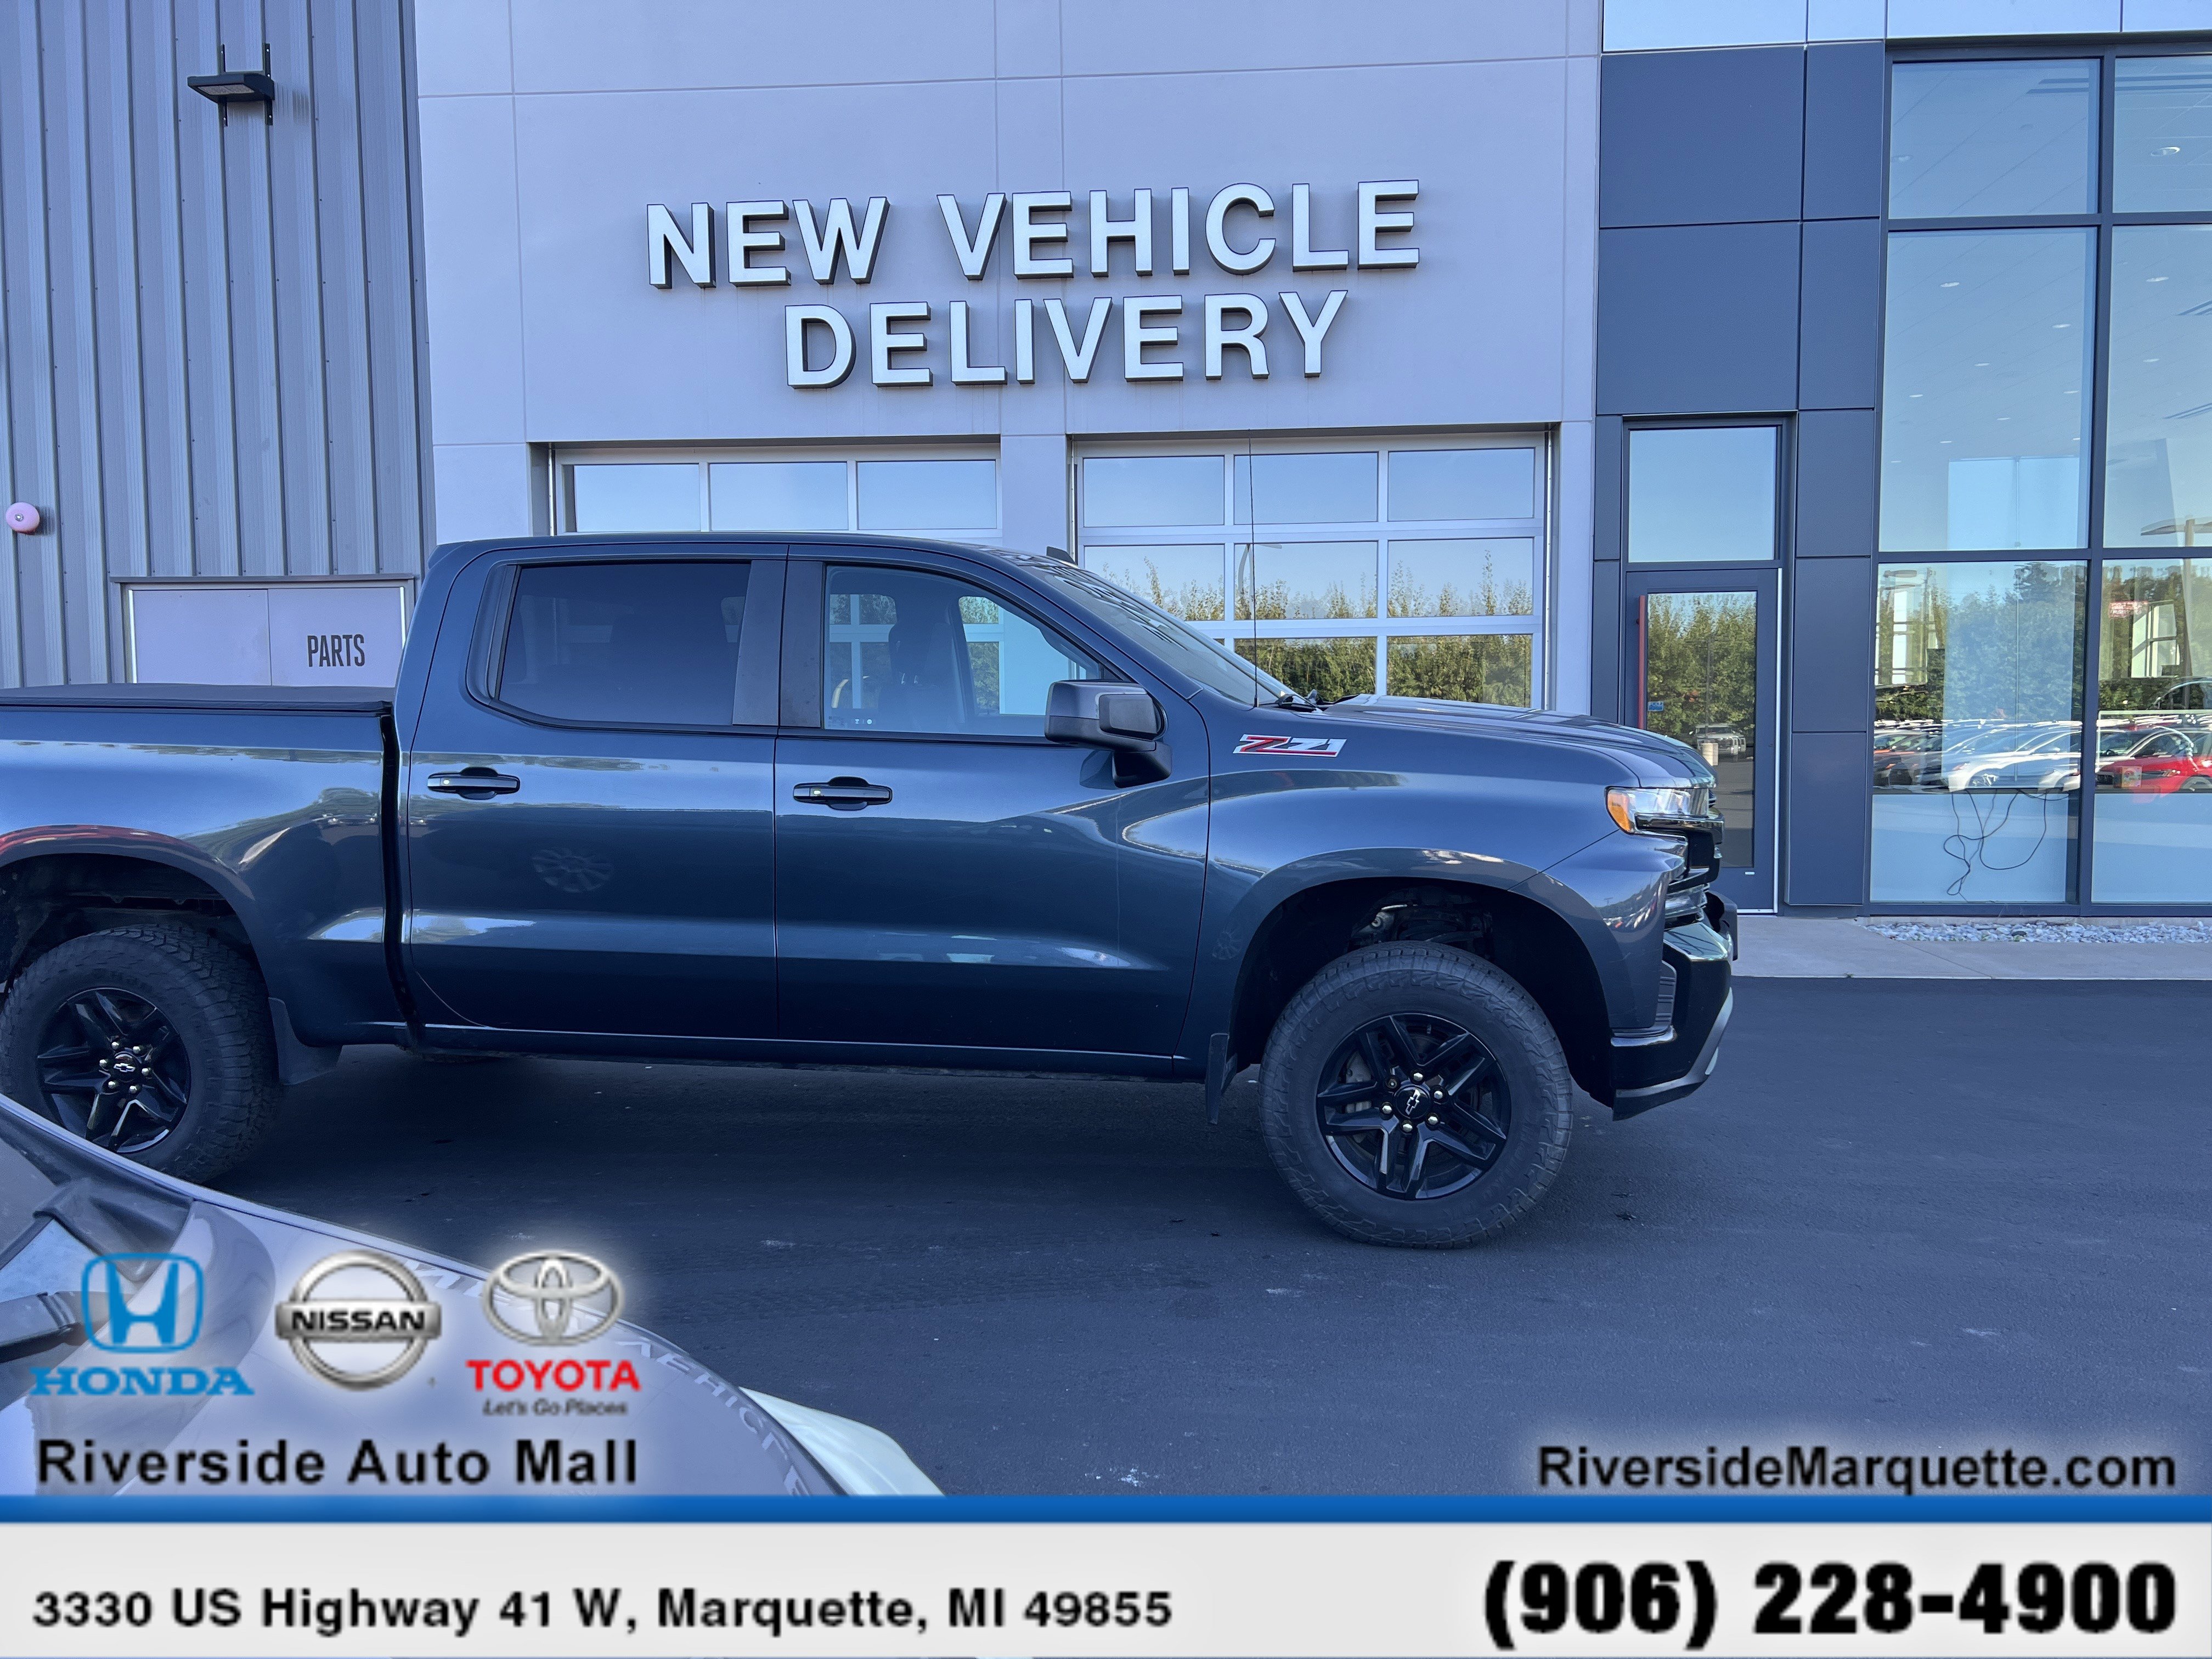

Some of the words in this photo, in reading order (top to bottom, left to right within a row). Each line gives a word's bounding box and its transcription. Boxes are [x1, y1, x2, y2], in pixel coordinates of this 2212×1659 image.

[647, 195, 889, 289] NEW
[936, 179, 1420, 280] VEHICLE
[785, 290, 1348, 389] DELIVERY
[307, 634, 365, 667] PARTS
[1233, 733, 1347, 758] Z71
